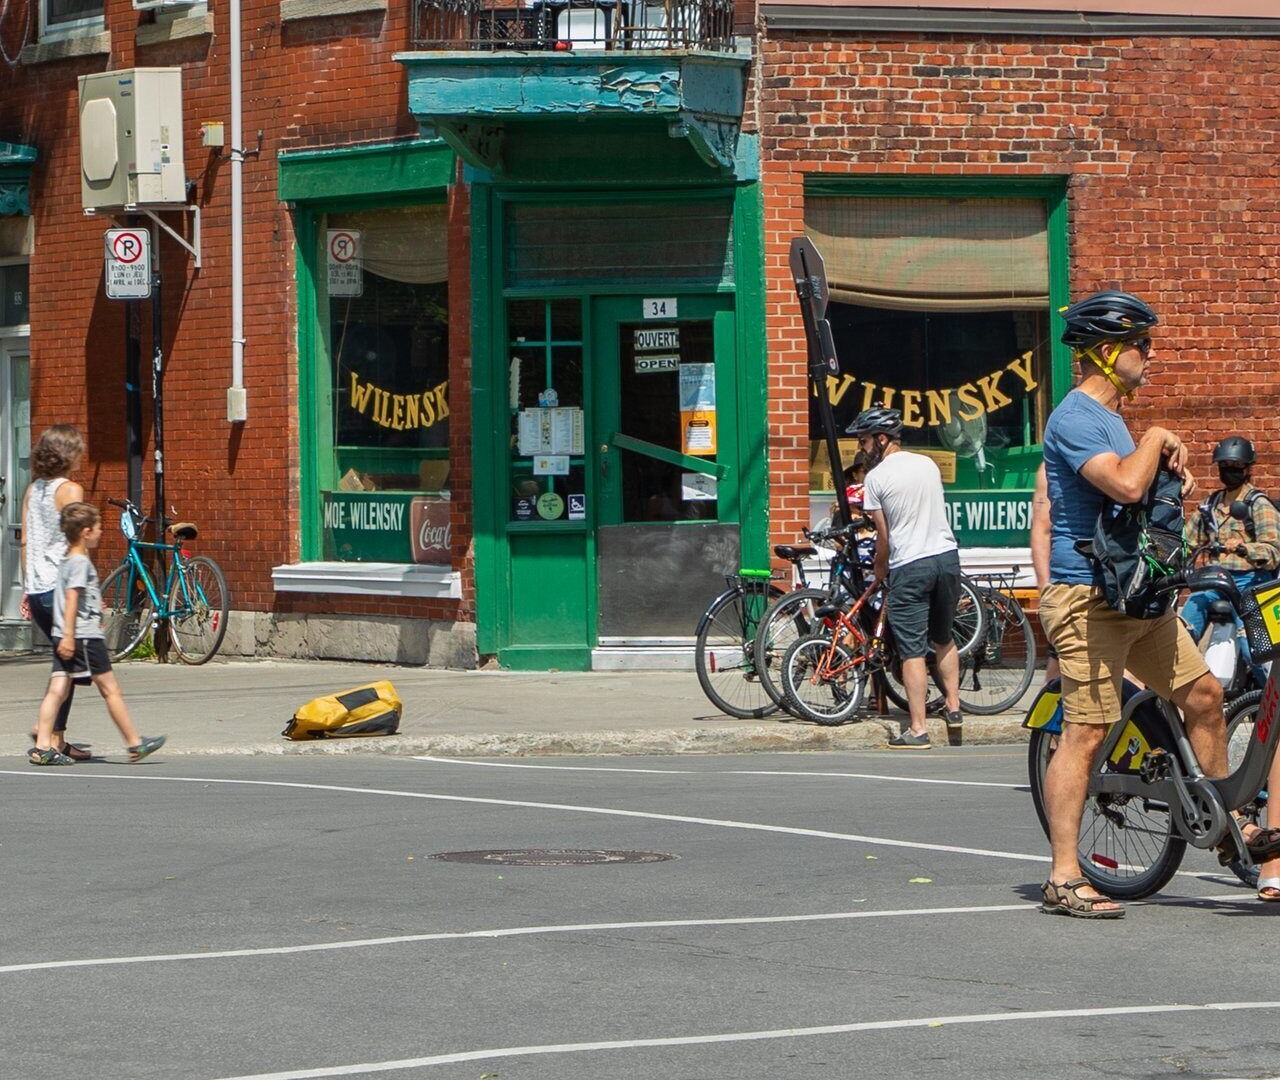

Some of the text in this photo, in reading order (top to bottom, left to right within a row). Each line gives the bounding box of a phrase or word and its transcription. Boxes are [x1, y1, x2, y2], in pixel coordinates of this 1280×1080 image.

[652, 301, 666, 316] 34
[637, 331, 676, 347] OUVERT
[639, 358, 676, 369] OPEN
[324, 502, 404, 531] MOE WILENSKY
